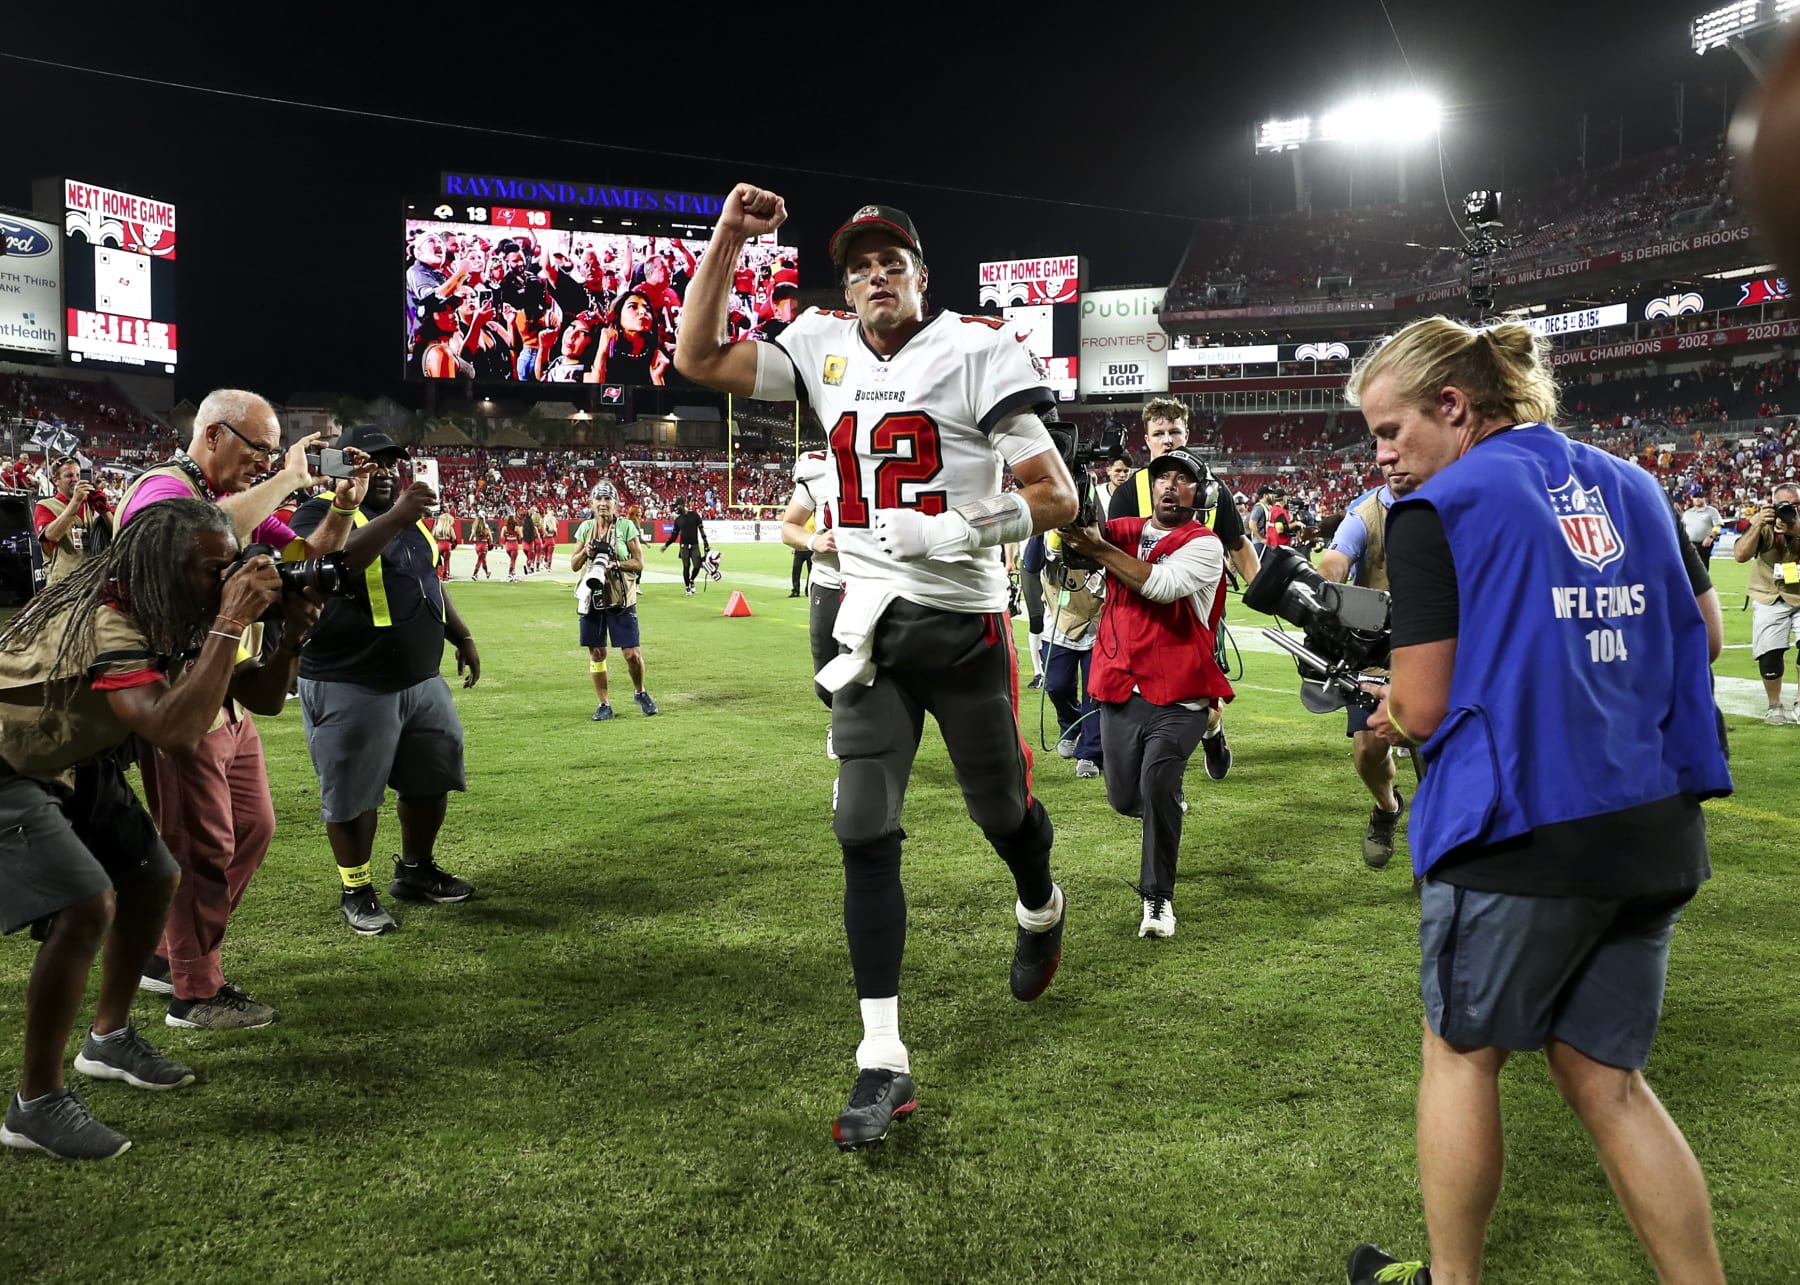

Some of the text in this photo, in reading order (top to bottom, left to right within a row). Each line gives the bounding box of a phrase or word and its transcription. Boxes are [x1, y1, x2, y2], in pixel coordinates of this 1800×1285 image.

[68, 183, 173, 228] NEXT HOME GAME
[447, 175, 727, 215] RAYMOND JAMES STAD
[466, 206, 488, 222] 13
[1620, 227, 1749, 263] 55 DERRICK BROOKS
[982, 258, 1075, 282] NEXT HOME GAME
[1518, 269, 1542, 283] MIKE
[1544, 259, 1591, 278] ALSTOTT
[1427, 290, 1450, 302] JOHN
[1082, 336, 1145, 348] FRONTIER
[1554, 352, 1588, 365] BOWL
[1589, 340, 1662, 361] CHAMPIONS
[1678, 334, 1708, 349] 2002
[1747, 324, 1780, 340] 2020
[1102, 375, 1145, 387] LIGHT
[1108, 363, 1139, 375] BUD
[830, 410, 948, 528] 12
[1560, 517, 1615, 557] NFL
[1551, 584, 1646, 619] NFL FILMS
[1585, 629, 1628, 663] 104
